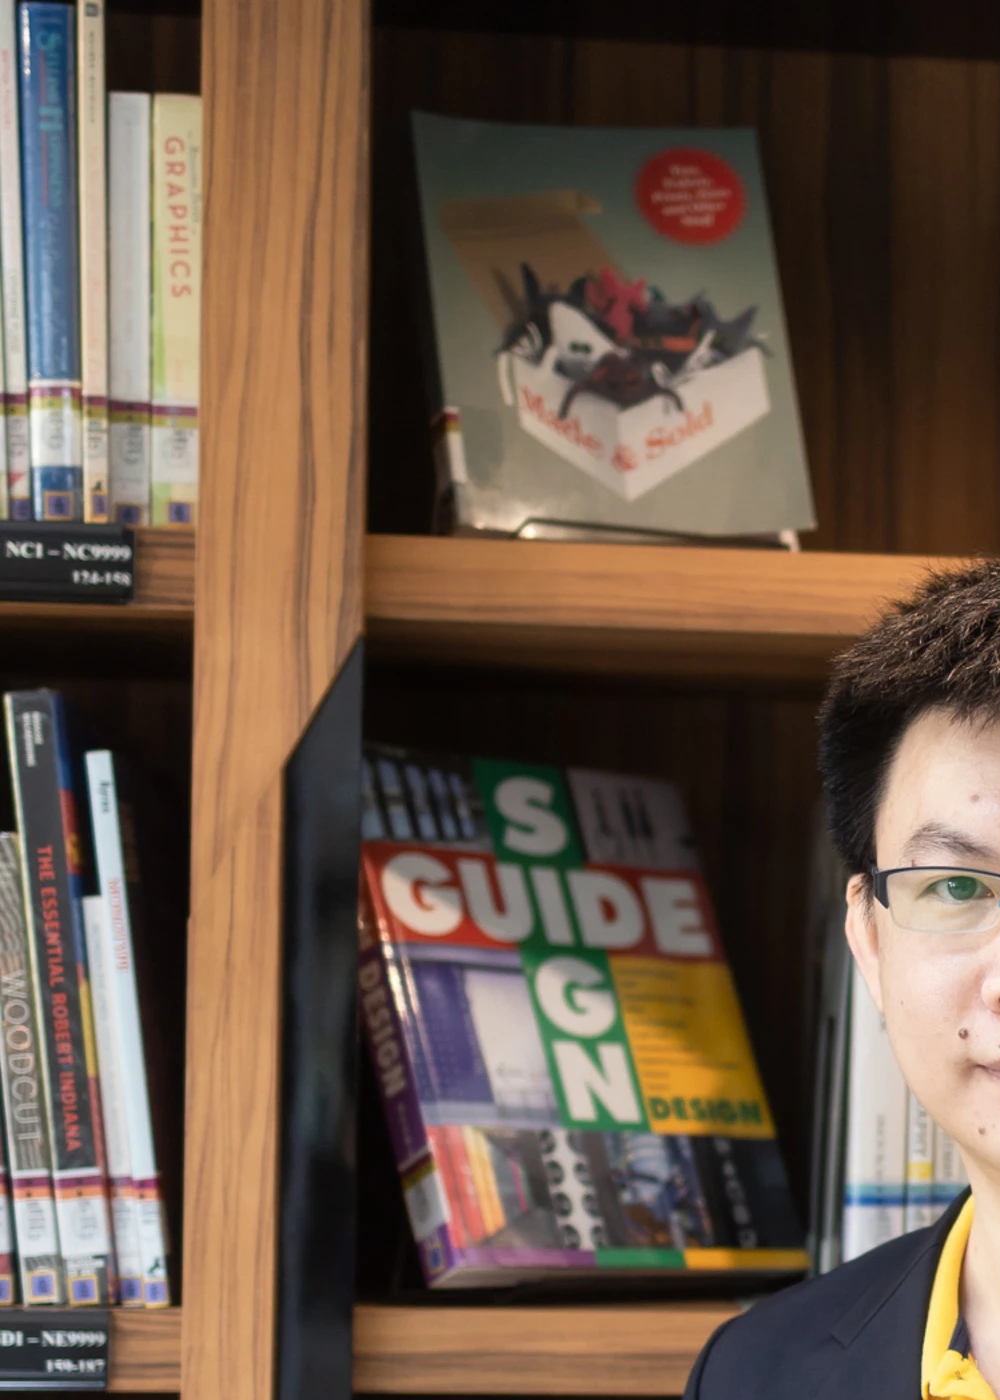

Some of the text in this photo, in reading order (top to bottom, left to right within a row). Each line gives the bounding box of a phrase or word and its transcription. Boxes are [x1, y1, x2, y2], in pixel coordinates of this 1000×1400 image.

[164, 137, 192, 300] GRAPHICS
[645, 402, 716, 461] Sold
[381, 850, 714, 957] GUIDE
[1, 970, 42, 1145] WOODCUT
[36, 845, 82, 1151] THE ESSENTIAL ROBERT INDIANA
[358, 956, 408, 1097] DESIGN
[647, 1096, 763, 1127] DESIGN
